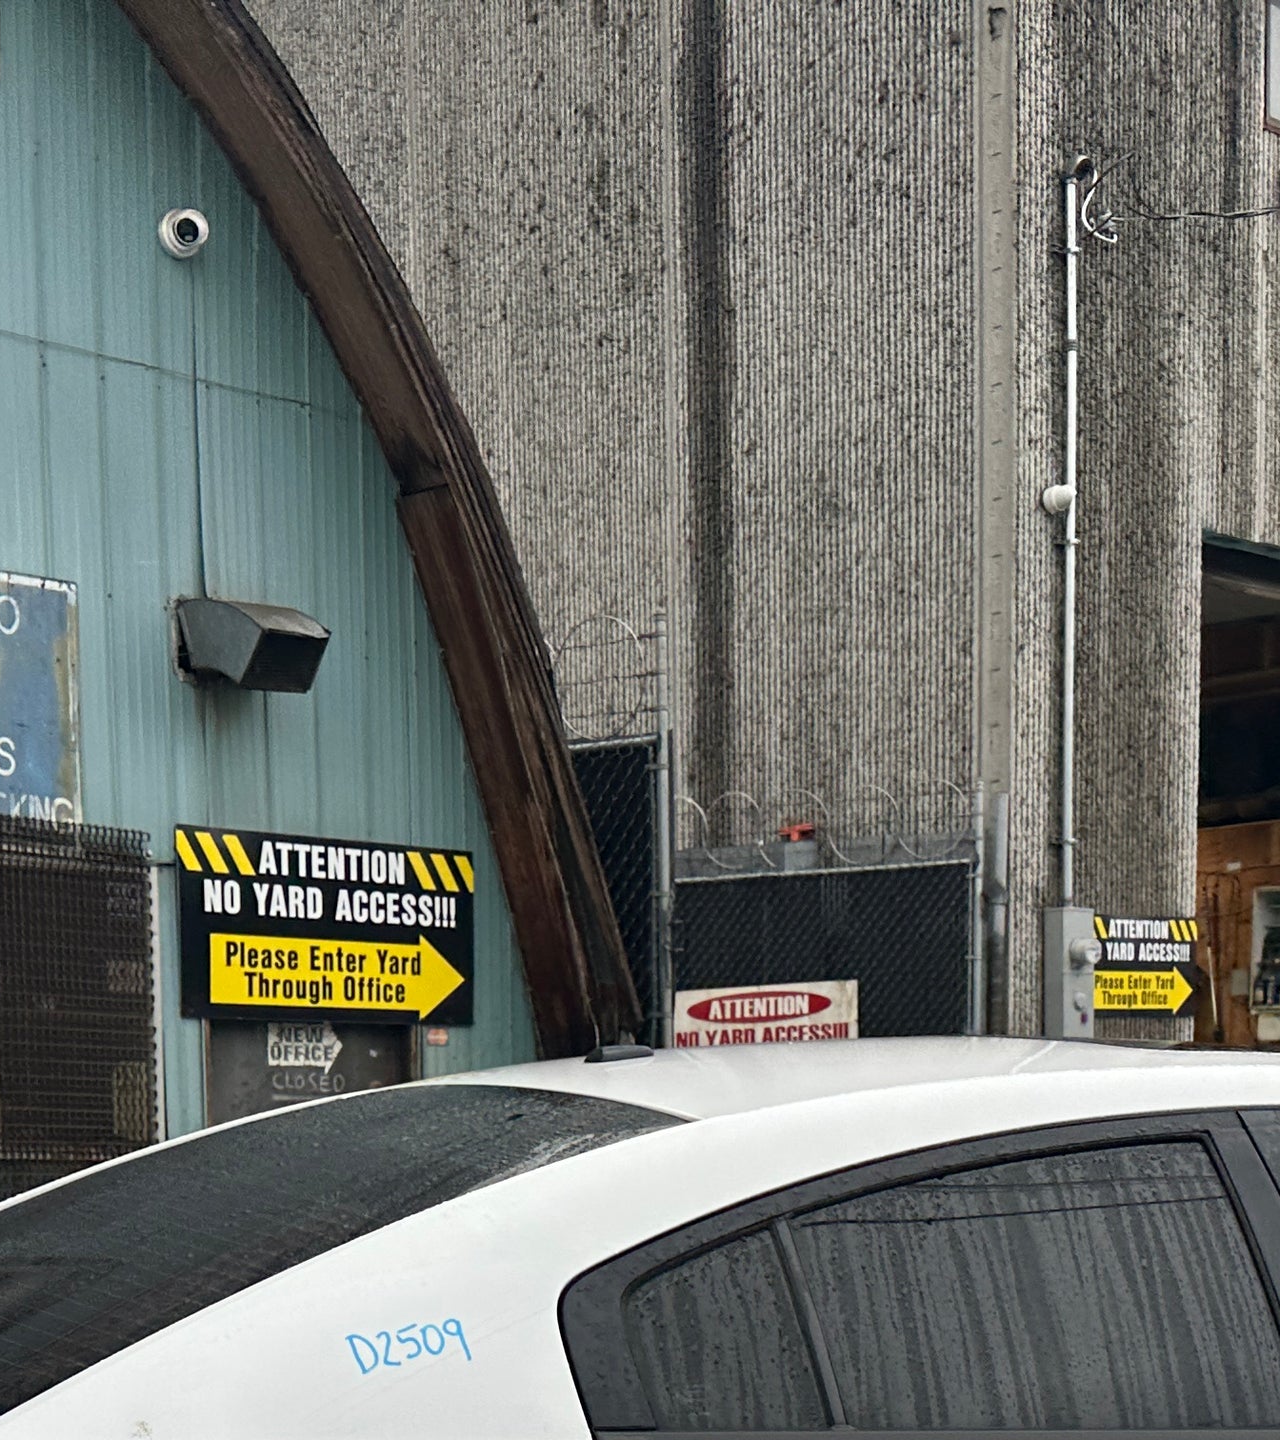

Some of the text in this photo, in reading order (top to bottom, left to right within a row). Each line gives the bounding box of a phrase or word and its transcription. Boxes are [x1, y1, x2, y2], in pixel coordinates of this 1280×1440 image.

[258, 840, 406, 886] ATTENTION
[203, 878, 457, 929] NO YARD ACCESS!!!
[1108, 918, 1169, 940] ATTENTION
[225, 941, 421, 976] Please Enter Yard
[1105, 941, 1191, 962] YARD ACCESS!!!
[244, 971, 406, 1005] Through Office
[1094, 974, 1175, 990] Please Enter Yard
[708, 994, 810, 1021] ATTENTION
[1102, 990, 1168, 1008] Through Office
[279, 1026, 323, 1043] NEW
[676, 1030, 700, 1048] NO
[705, 1028, 756, 1046] YARD
[269, 1043, 335, 1062] OFFICE
[271, 1070, 346, 1093] CLOSED
[344, 1317, 472, 1375] D2509
